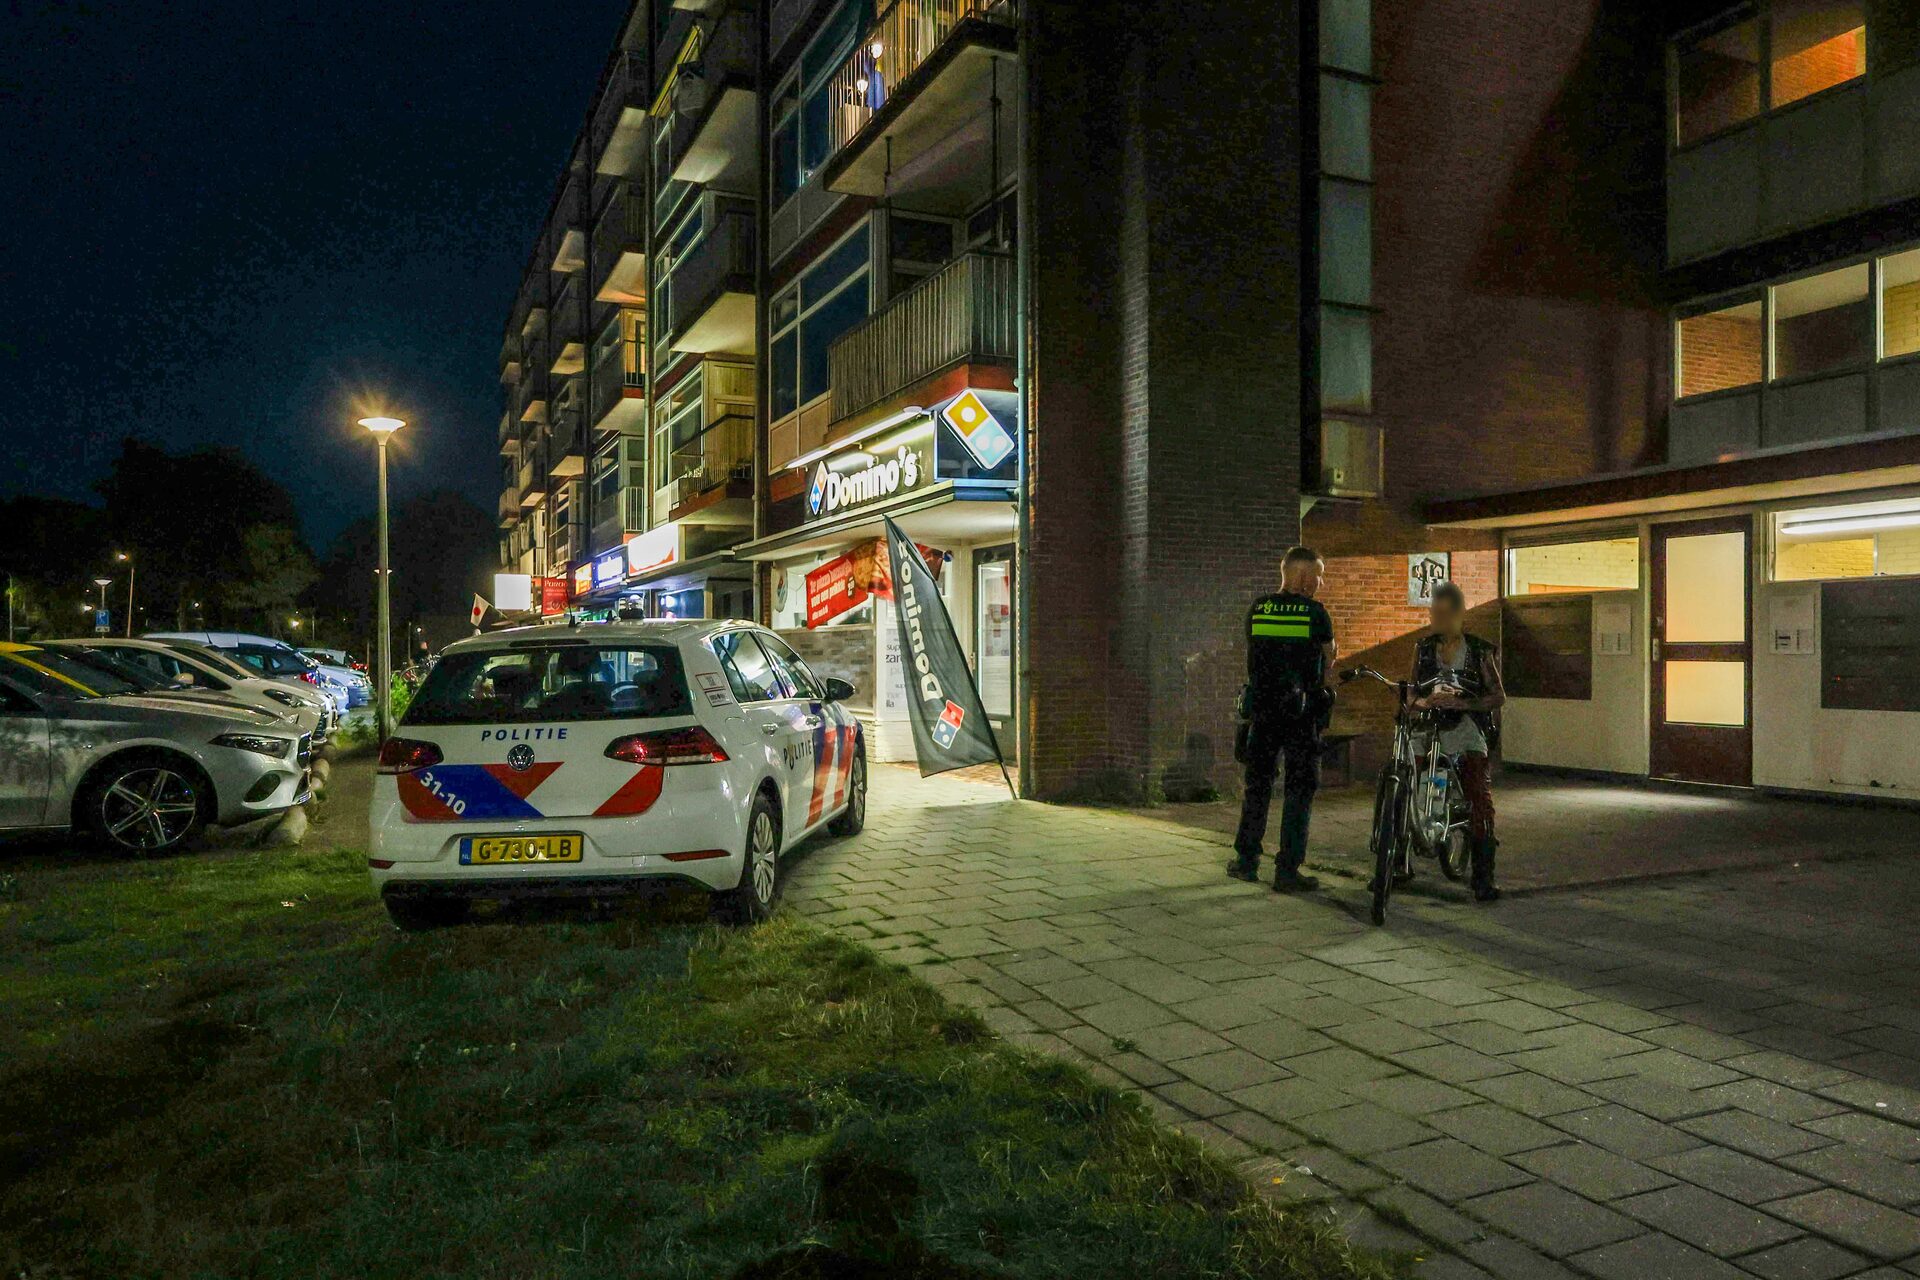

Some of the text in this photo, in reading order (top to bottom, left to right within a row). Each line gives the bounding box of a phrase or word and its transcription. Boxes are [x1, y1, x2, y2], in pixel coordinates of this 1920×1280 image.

[827, 445, 918, 511] Domino's
[1257, 600, 1306, 614] POLITIE
[481, 727, 568, 741] POLITIE
[420, 771, 466, 815] 31-10
[479, 839, 572, 860] G-730-LB
